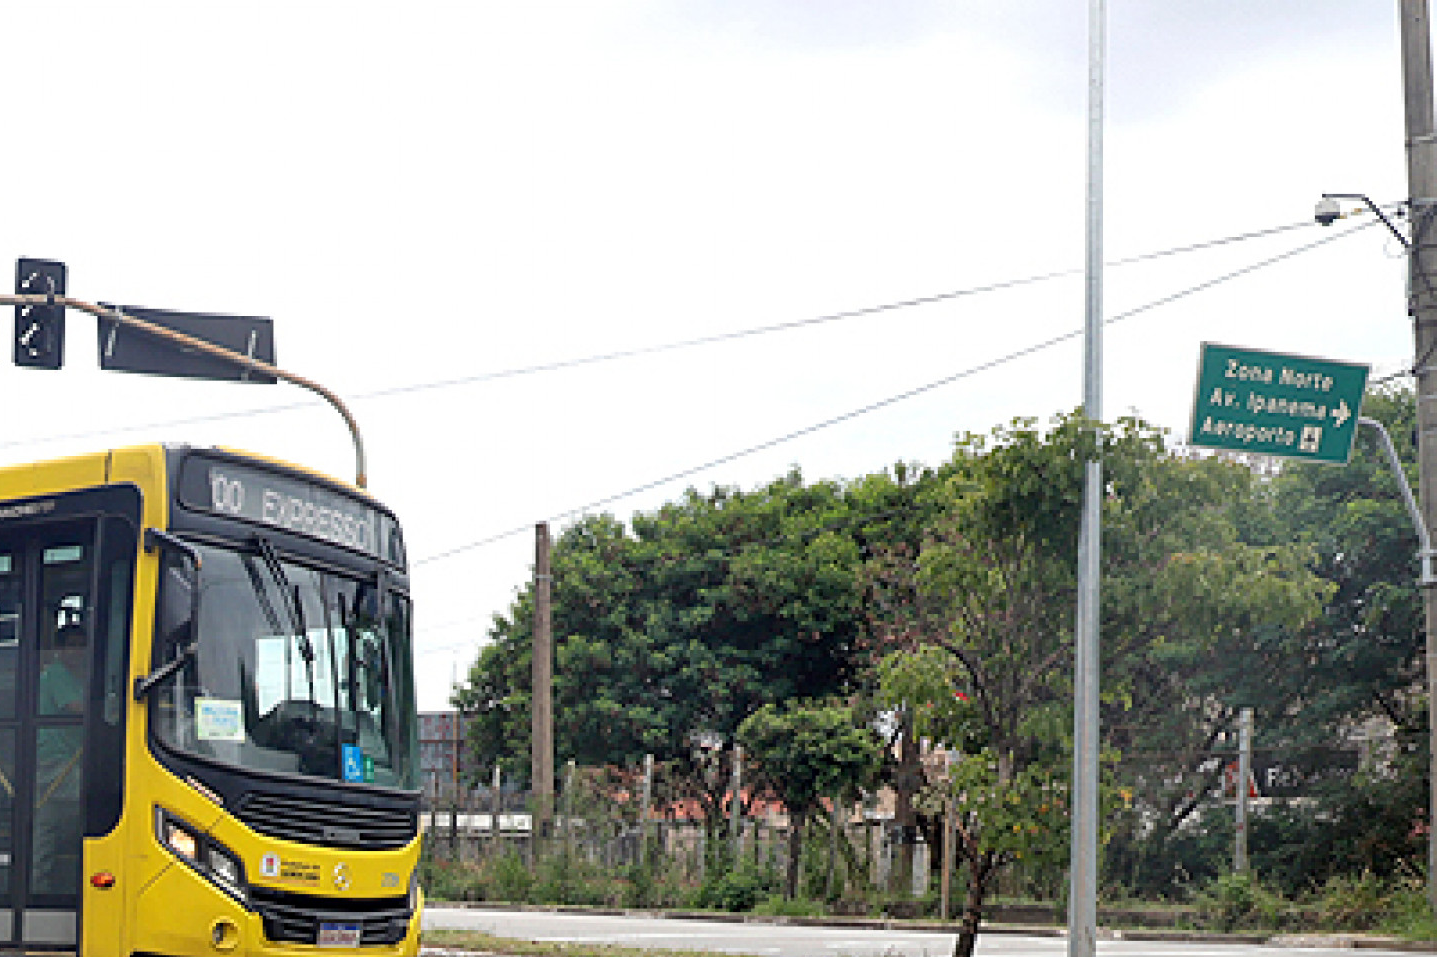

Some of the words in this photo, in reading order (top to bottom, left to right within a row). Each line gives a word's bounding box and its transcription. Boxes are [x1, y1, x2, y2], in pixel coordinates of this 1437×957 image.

[1225, 358, 1273, 384] Zona
[1279, 366, 1334, 391] Norte
[1210, 387, 1240, 409] Av.
[1246, 391, 1327, 420] Ipanema
[1200, 416, 1295, 445] Aeroporto
[209, 472, 245, 514] 00
[263, 489, 370, 553] EXPRESSO
